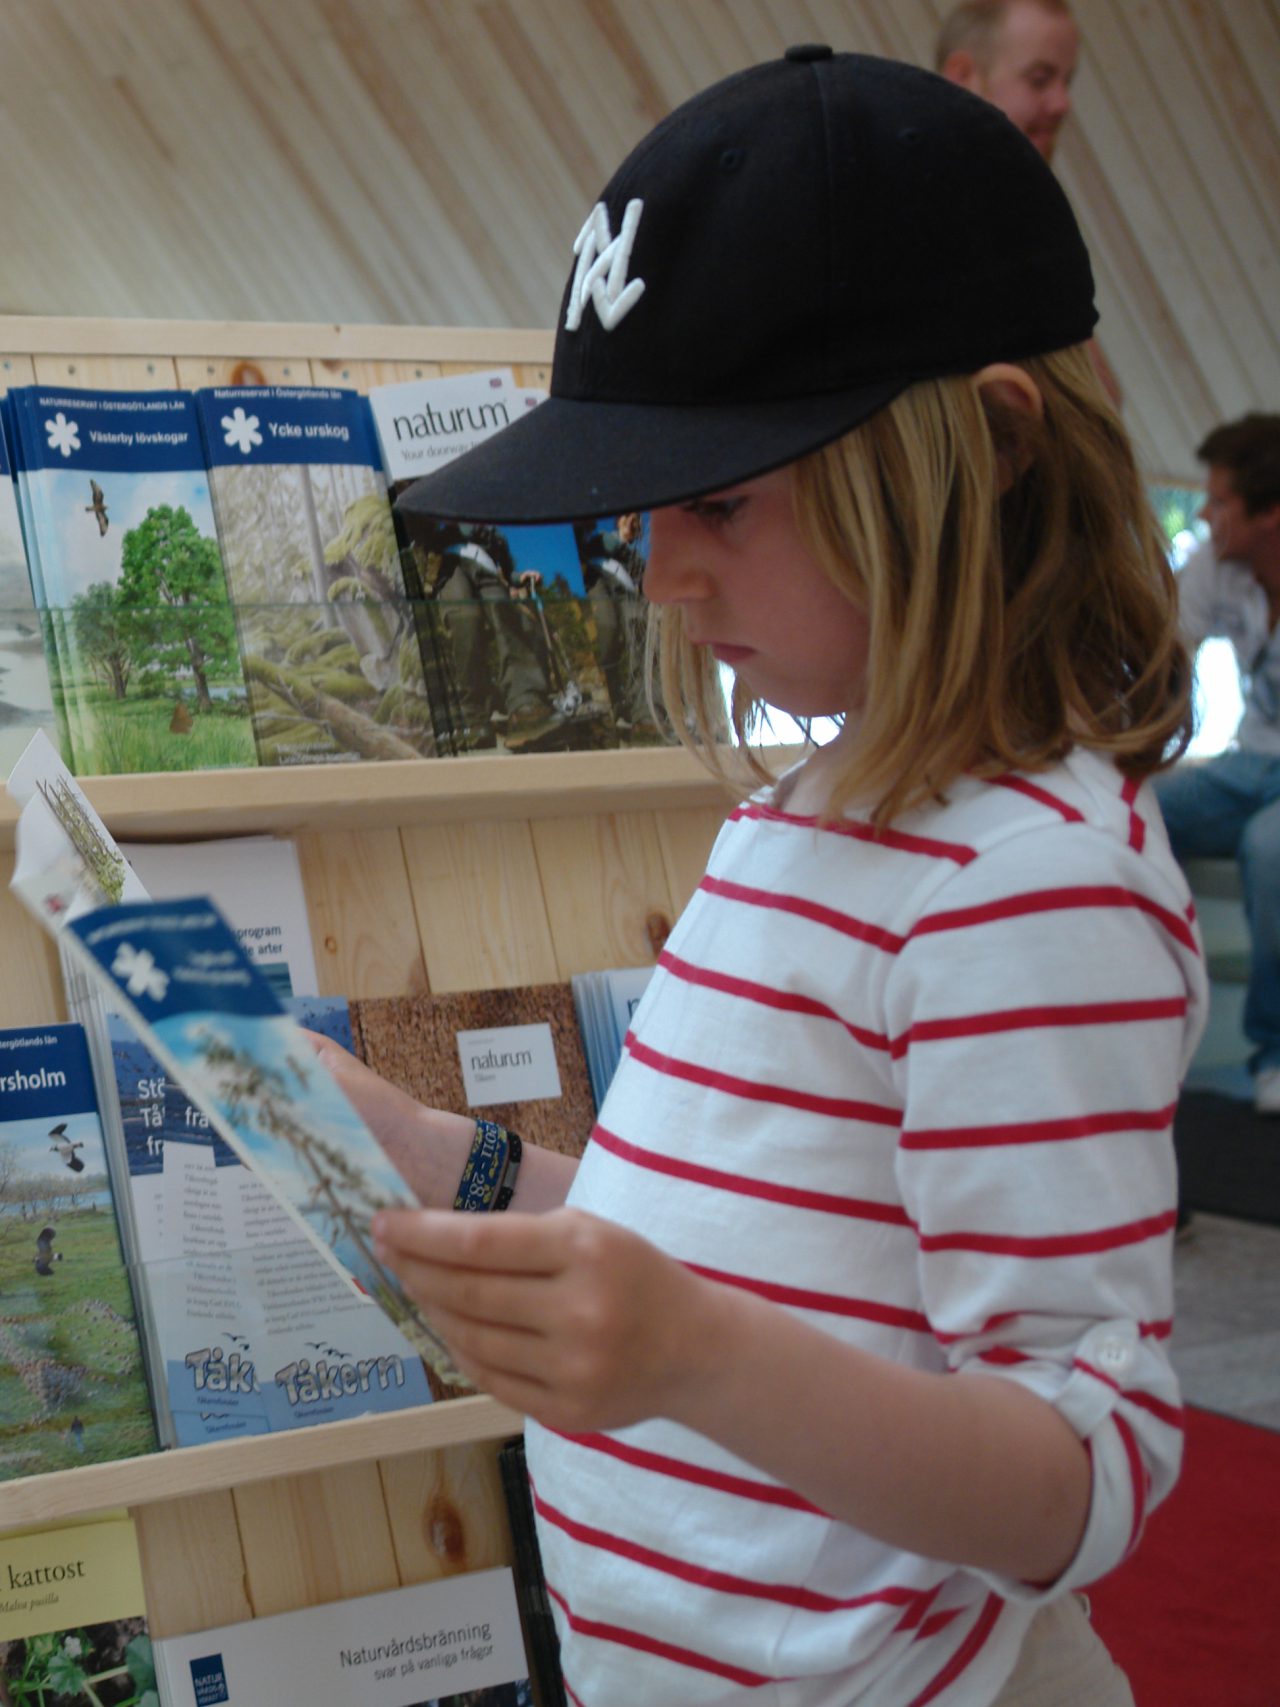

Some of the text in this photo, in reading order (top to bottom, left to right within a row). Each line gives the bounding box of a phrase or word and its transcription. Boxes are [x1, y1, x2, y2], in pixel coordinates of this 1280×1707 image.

[268, 422, 350, 443] Ycke urskog
[393, 402, 511, 442] naturum
[89, 430, 189, 447] Västerby lövskogar
[258, 942, 284, 955] arter
[471, 1048, 533, 1072] naturum
[139, 1103, 166, 1128] Tå
[7, 1560, 86, 1591] kattost
[339, 1623, 493, 1669] Naturvårdsbränning
[374, 1645, 493, 1681] svar på vanliga frågor
